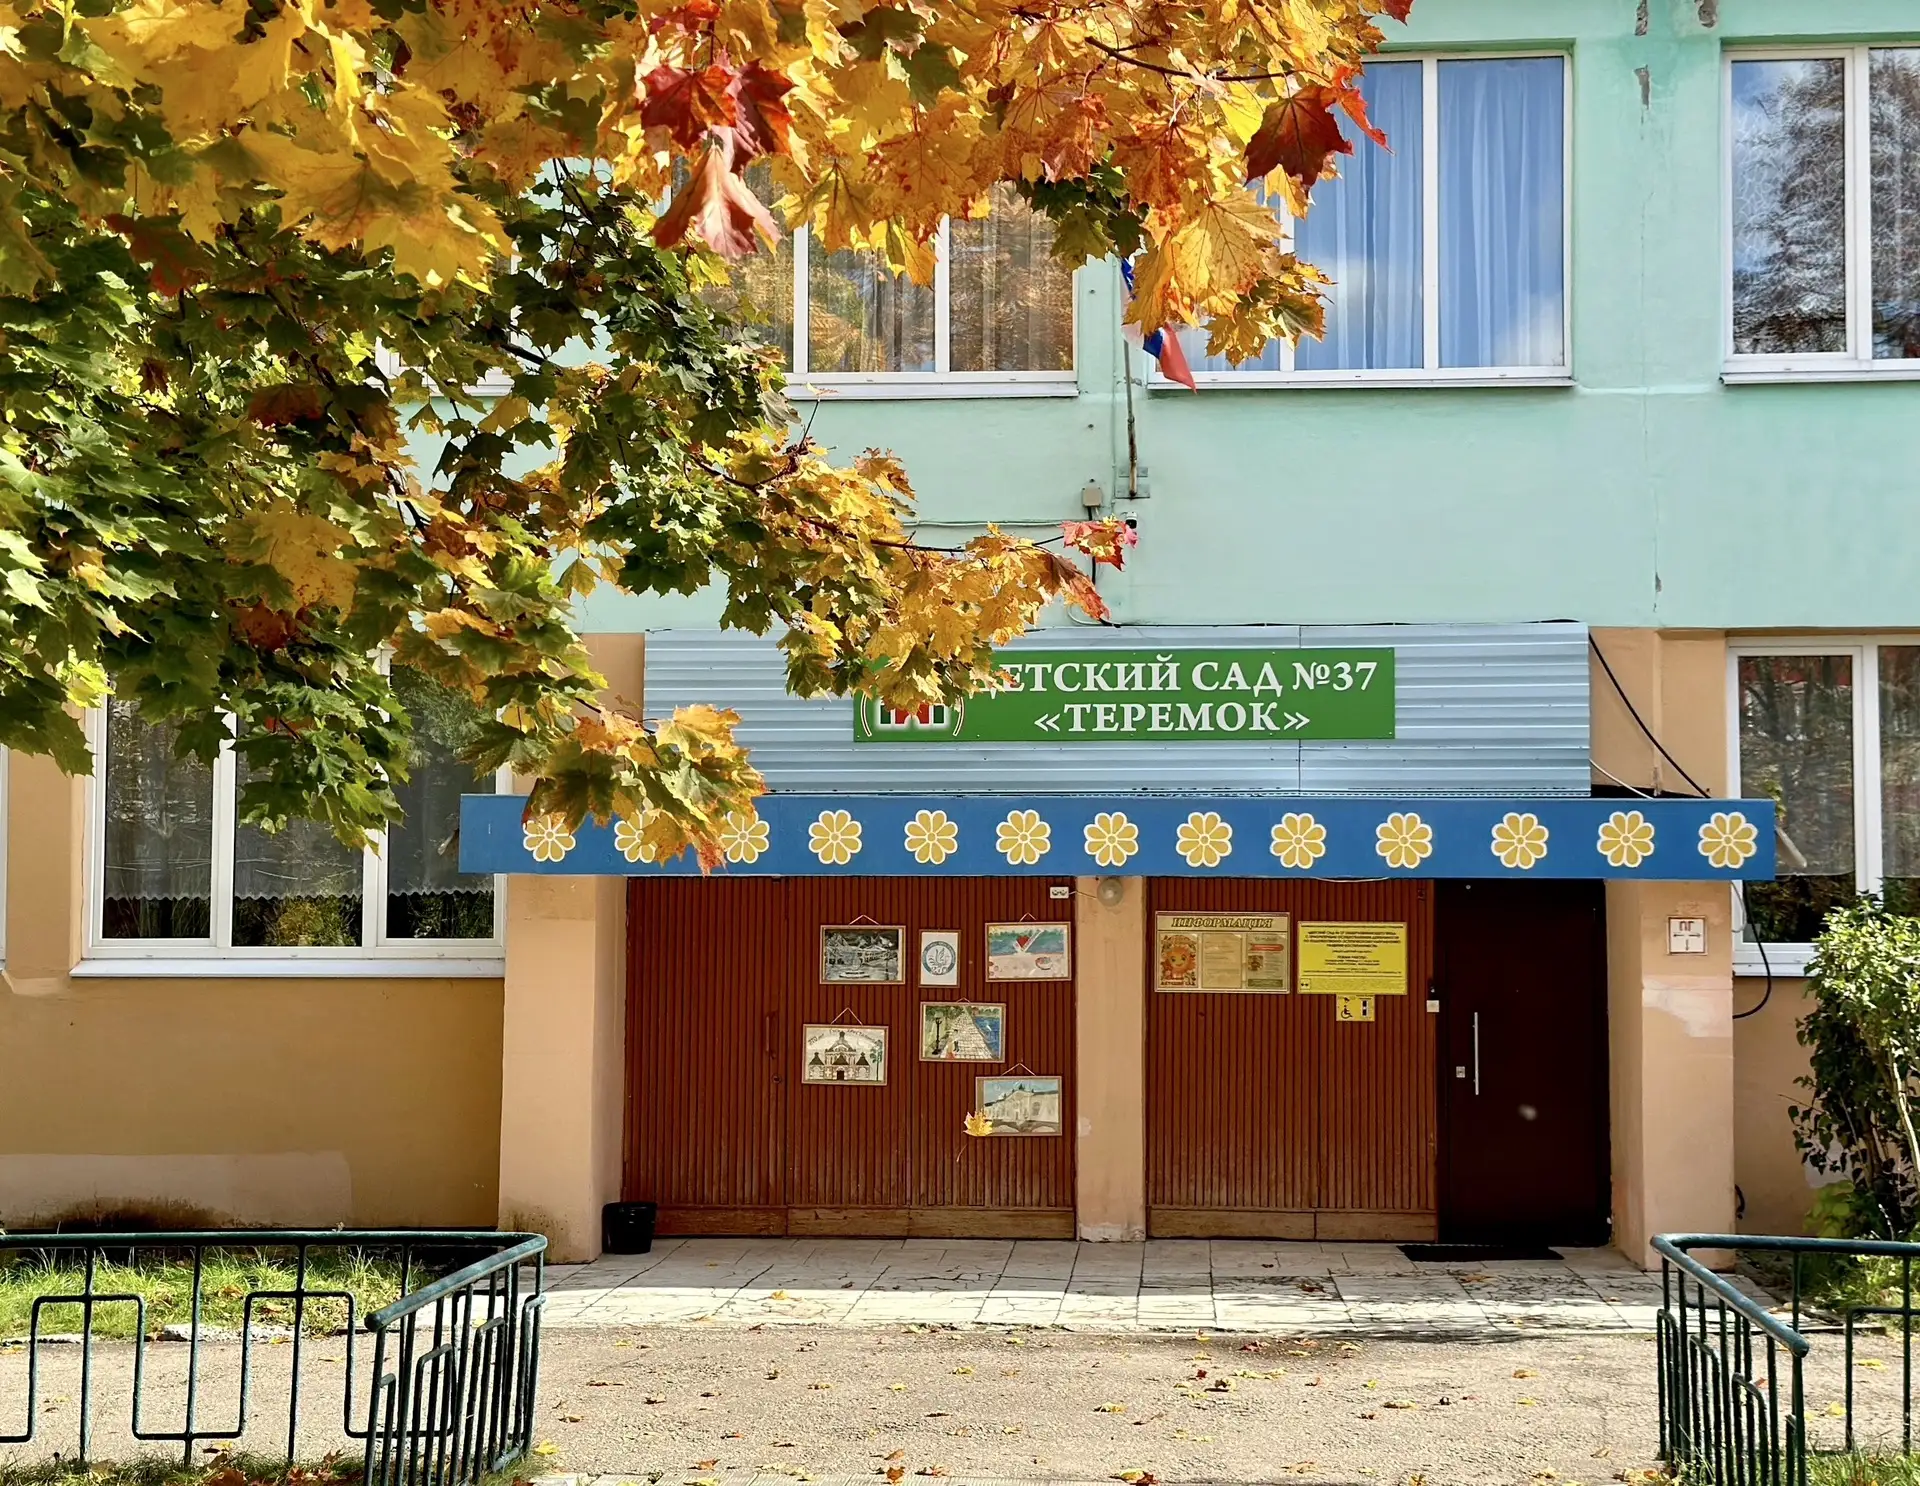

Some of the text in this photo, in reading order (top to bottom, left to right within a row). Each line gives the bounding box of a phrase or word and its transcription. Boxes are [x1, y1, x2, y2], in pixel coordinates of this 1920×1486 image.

[1192, 662, 1283, 697] САД
[1292, 660, 1378, 692] №37
[1034, 701, 1311, 733] «ТЕРЕМОК»
[1171, 917, 1274, 930] ИНФОРМАЦИЯ
[1679, 920, 1694, 931] ПГ
